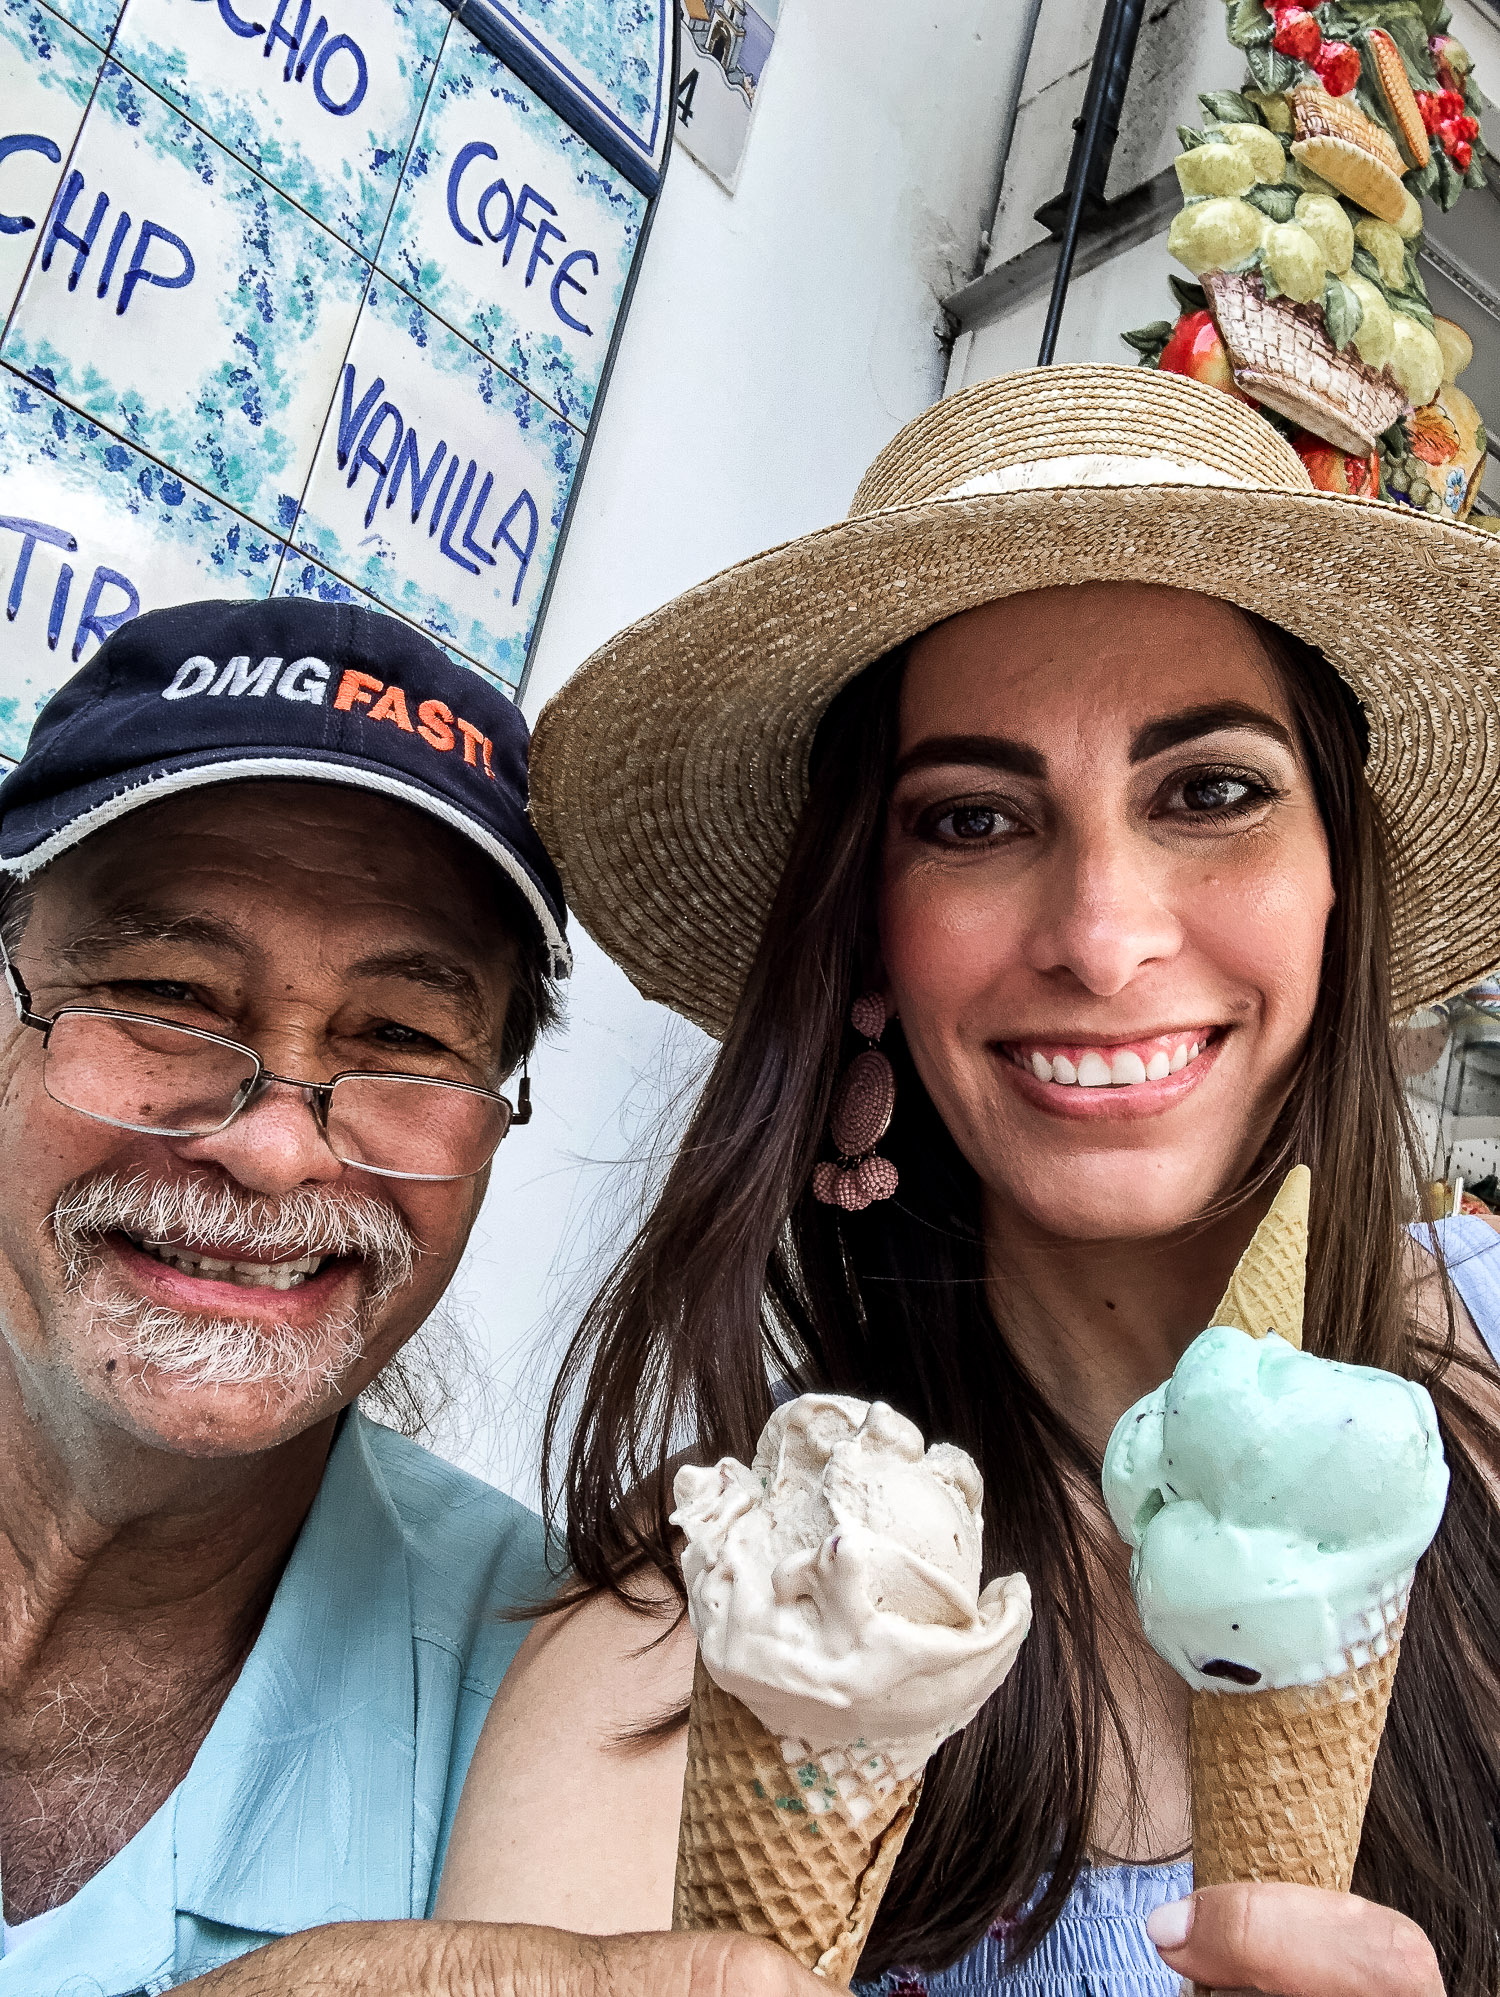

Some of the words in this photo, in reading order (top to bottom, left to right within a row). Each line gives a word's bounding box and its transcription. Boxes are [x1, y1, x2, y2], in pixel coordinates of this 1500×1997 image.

[0, 133, 195, 316] CHIP
[446, 141, 599, 337] COFFE
[337, 363, 539, 607] VANILLA
